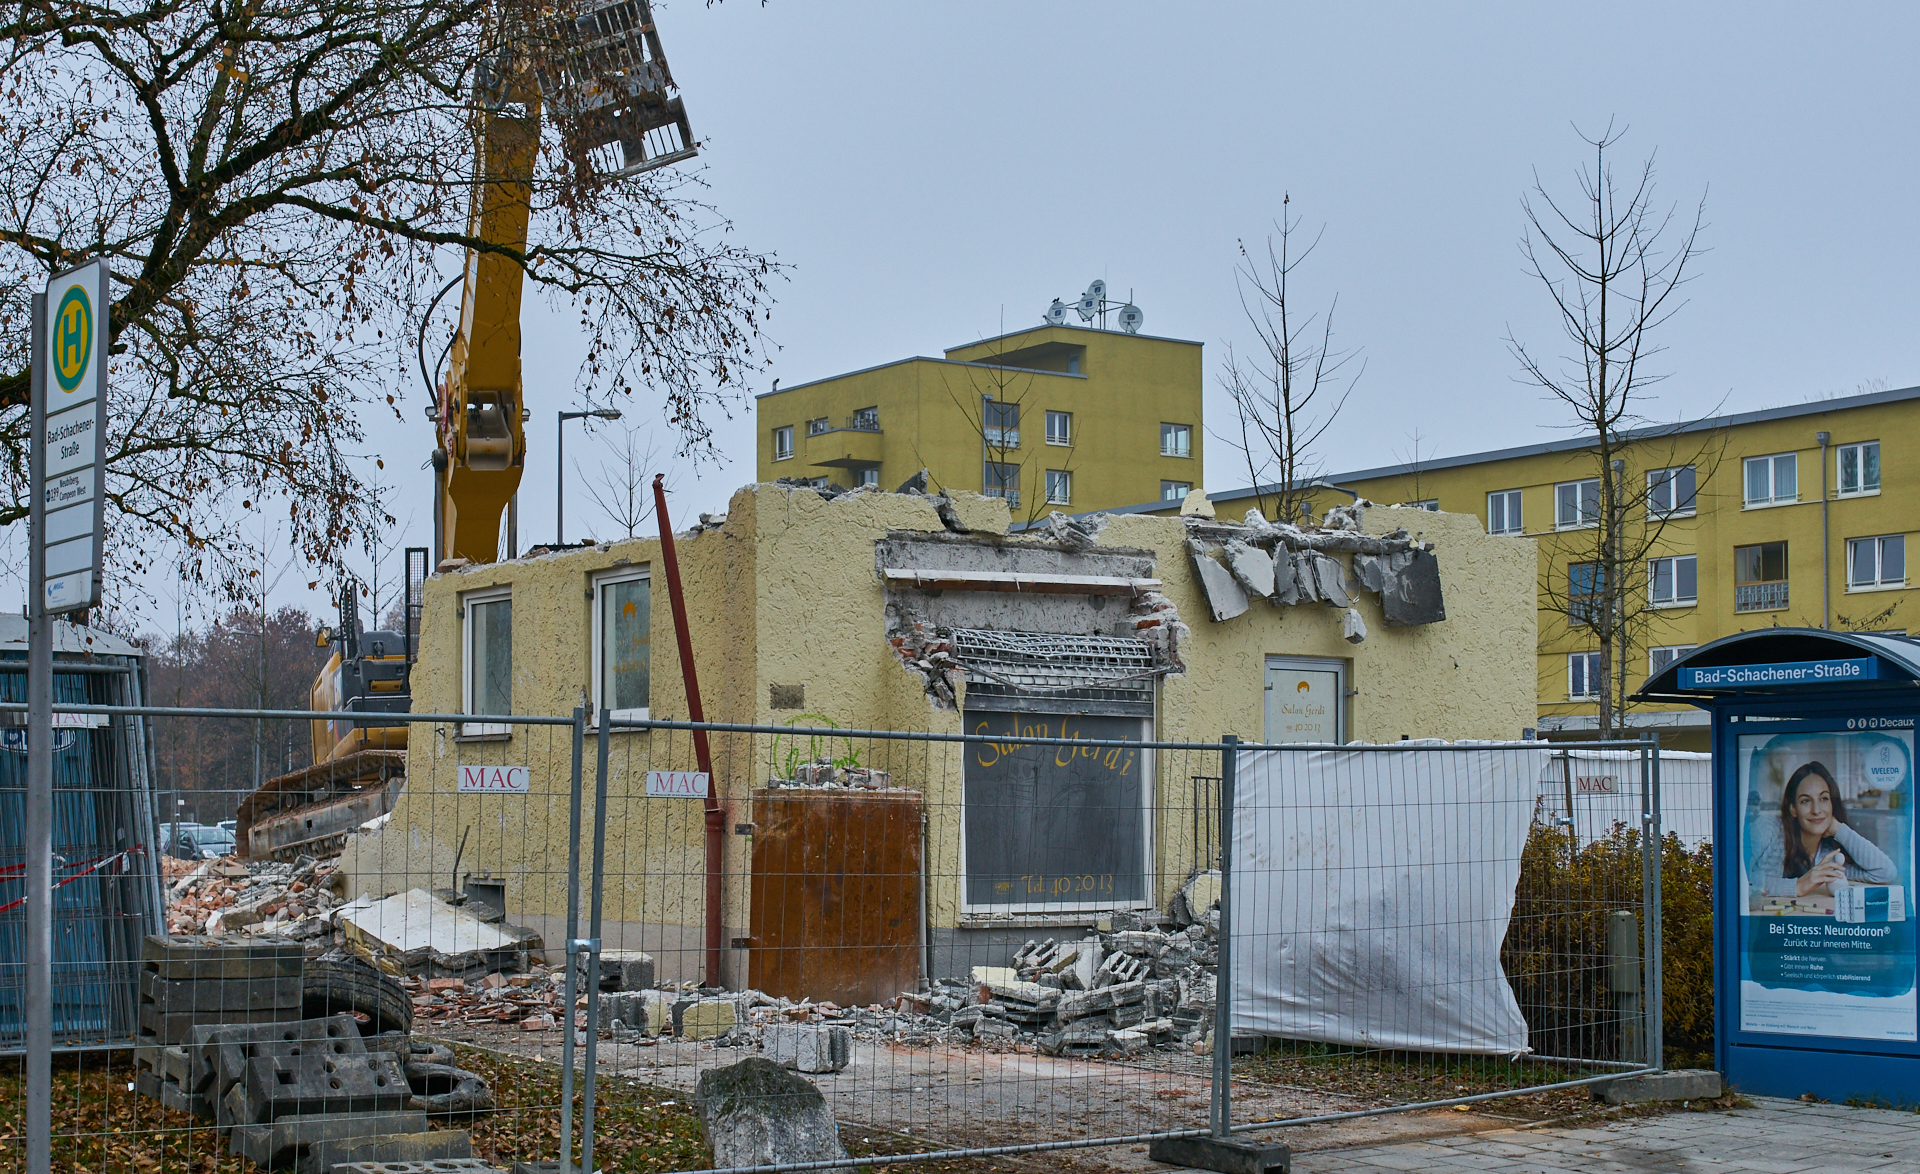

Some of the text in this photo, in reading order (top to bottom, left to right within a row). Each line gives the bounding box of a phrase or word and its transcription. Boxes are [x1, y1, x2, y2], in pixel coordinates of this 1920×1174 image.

[63, 308, 83, 370] H
[47, 419, 95, 445] Bad-Schachener-
[60, 441, 80, 460] Straße
[50, 486, 59, 499] 199
[77, 485, 87, 496] West
[1694, 662, 1860, 684] Bad-Schachener-Straße
[1281, 703, 1325, 718] Salon Gerdi
[1294, 723, 1303, 732] 40
[1304, 723, 1313, 732] 20
[1880, 717, 1915, 728] Decaux
[975, 712, 1135, 776] Salon Gerdi
[463, 767, 522, 789] MAC
[1871, 767, 1899, 775] WELEDA
[654, 772, 706, 793] MAC
[1579, 776, 1612, 790] MAC
[1021, 873, 1113, 897] Tel. 40 20 13
[1769, 923, 1785, 935] Bei
[1787, 924, 1822, 936] Stress:
[1783, 938, 1873, 950] Zurück zur inneren Mitte.
[1810, 963, 1824, 971] Ruhe
[1783, 971, 1804, 979] Seelisch
[1813, 972, 1836, 980] körperlich
[1836, 974, 1871, 982] stabilisierend
